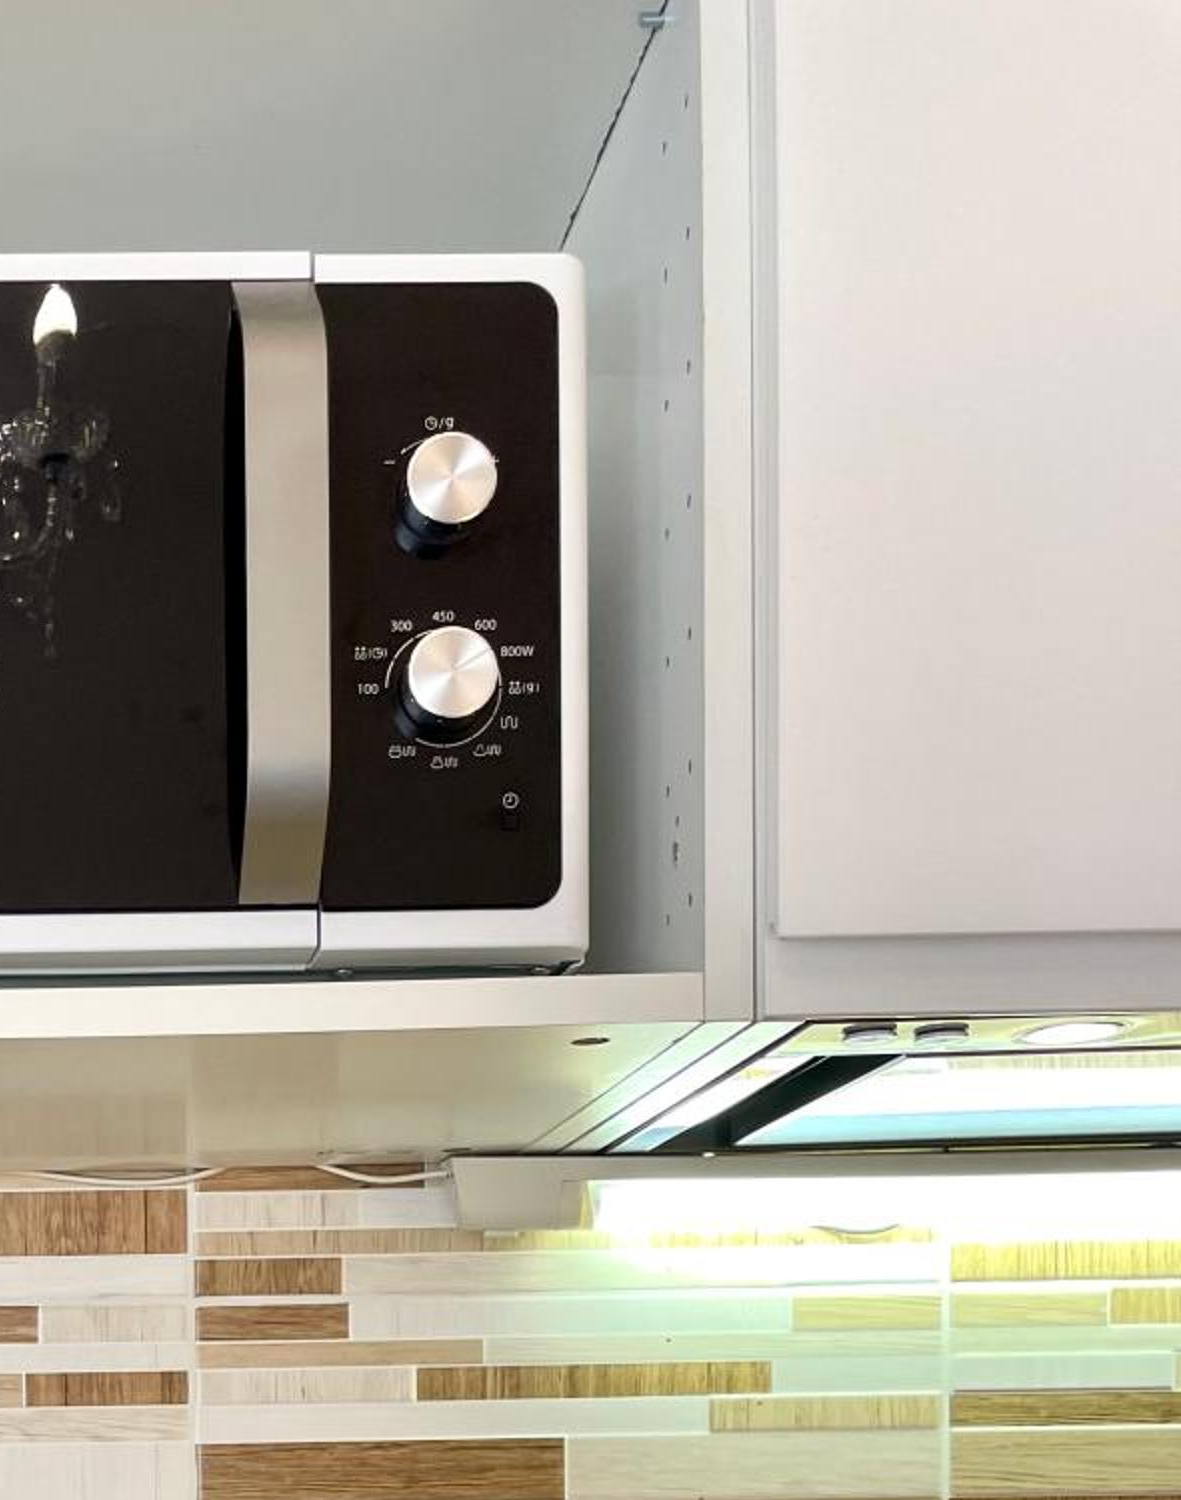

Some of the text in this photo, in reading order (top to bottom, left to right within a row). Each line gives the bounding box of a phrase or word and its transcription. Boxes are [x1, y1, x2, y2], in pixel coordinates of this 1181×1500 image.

[432, 611, 455, 622] 450
[390, 620, 414, 632] 300
[474, 619, 498, 631] 600
[500, 646, 535, 657] 800W
[357, 683, 380, 695] 100
